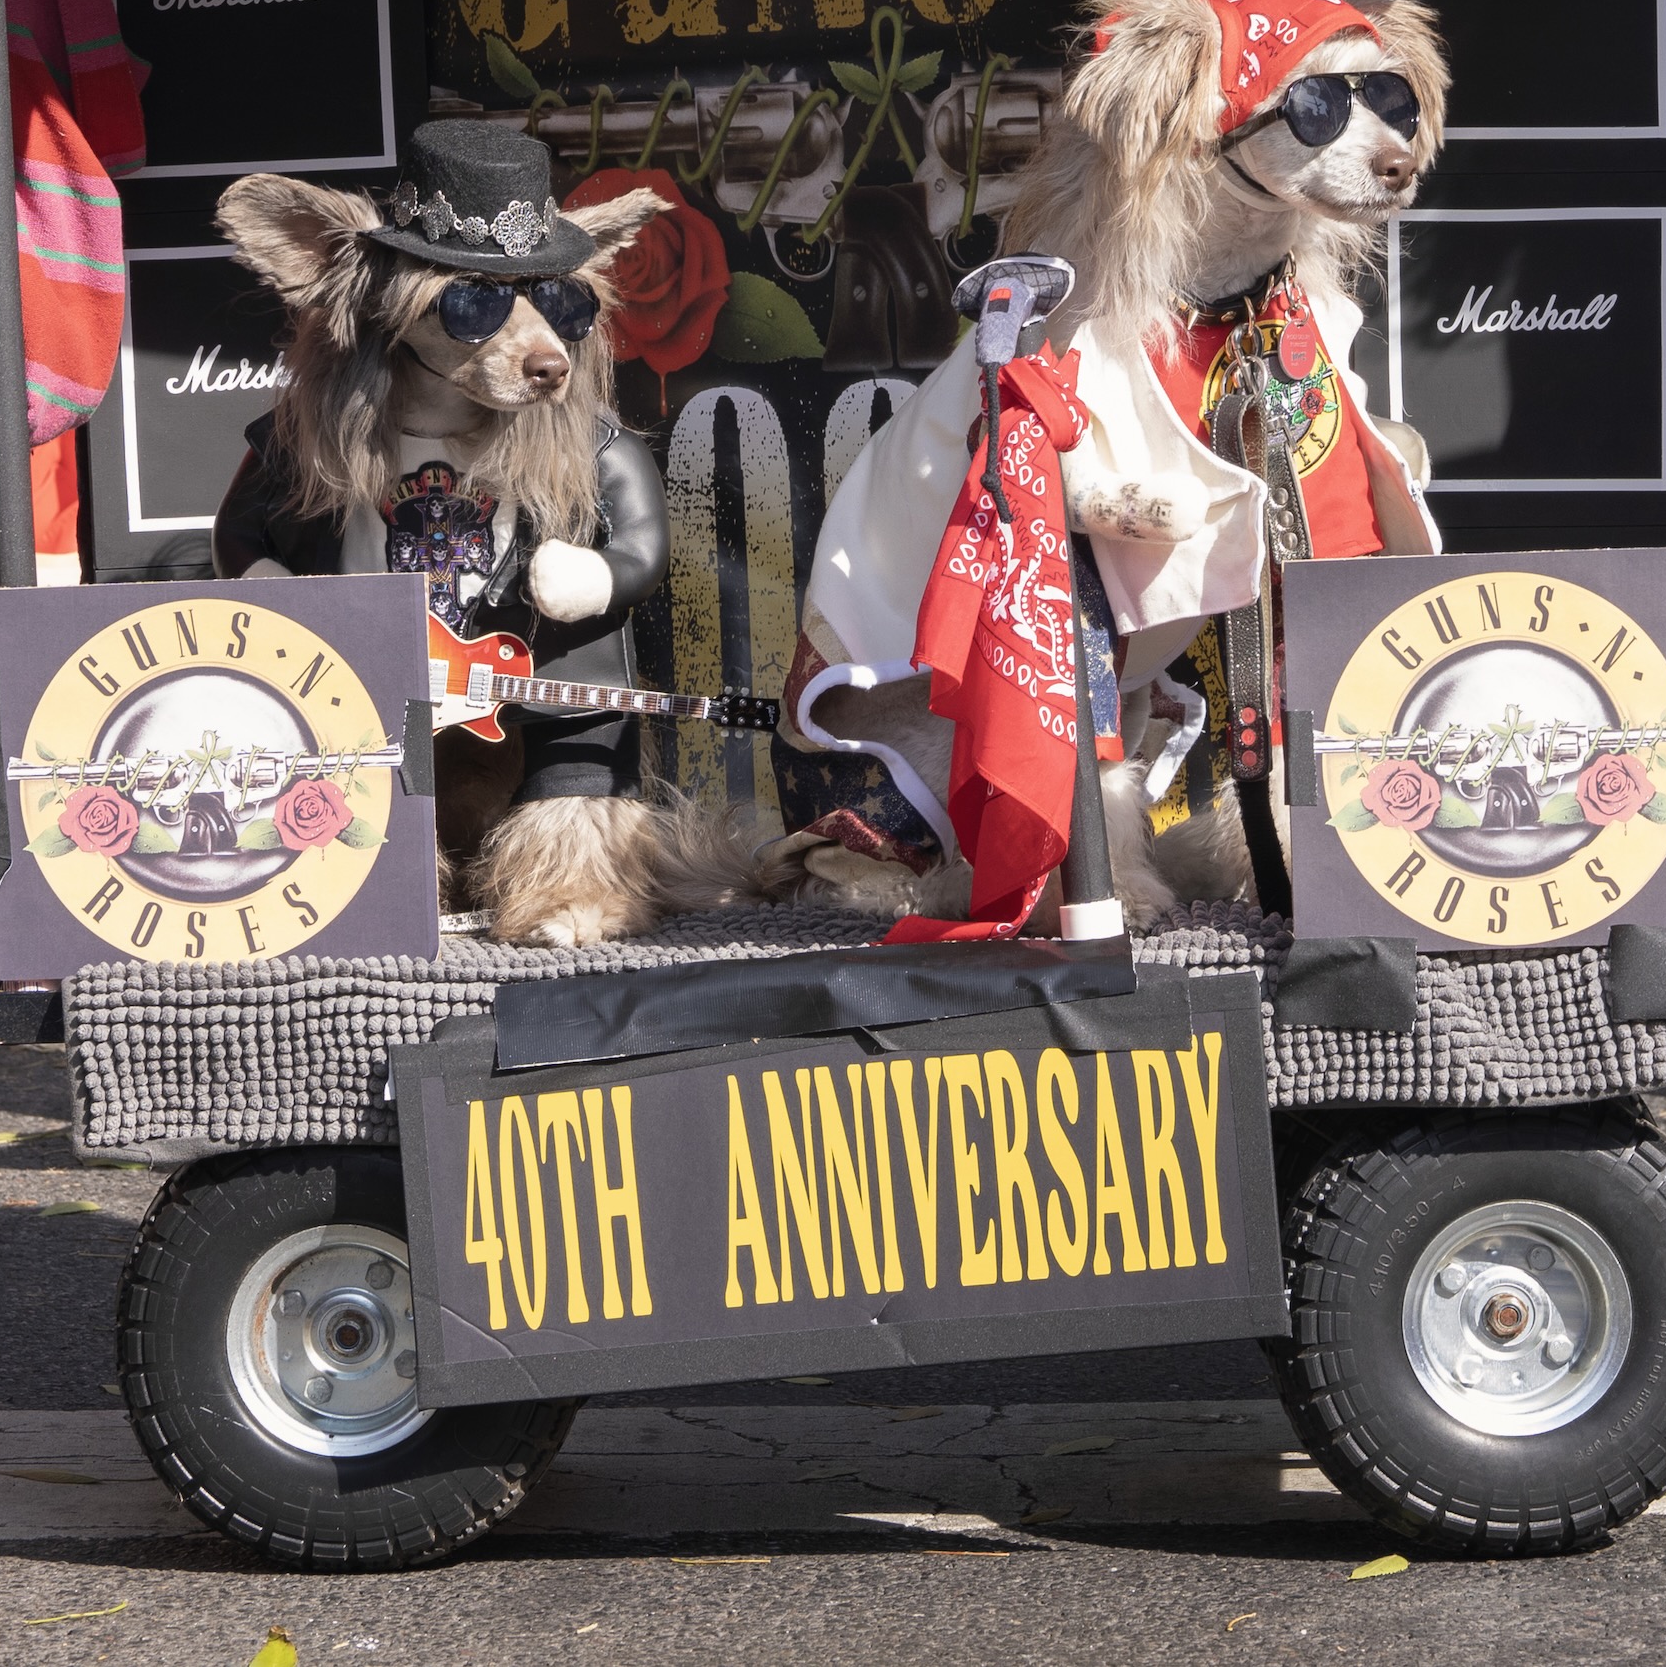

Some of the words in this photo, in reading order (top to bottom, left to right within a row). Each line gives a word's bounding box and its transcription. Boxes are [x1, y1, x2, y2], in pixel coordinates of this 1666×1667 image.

[1437, 284, 1618, 334] Marshall
[77, 608, 253, 698] GUNS
[1380, 582, 1555, 671] GUNS
[81, 874, 319, 959] ROSES
[1383, 848, 1622, 934] ROSES
[463, 1085, 653, 1332] 40TH
[724, 1031, 1229, 1309] ANNIVERSARY
[1647, 1354, 1664, 1385] FOR
